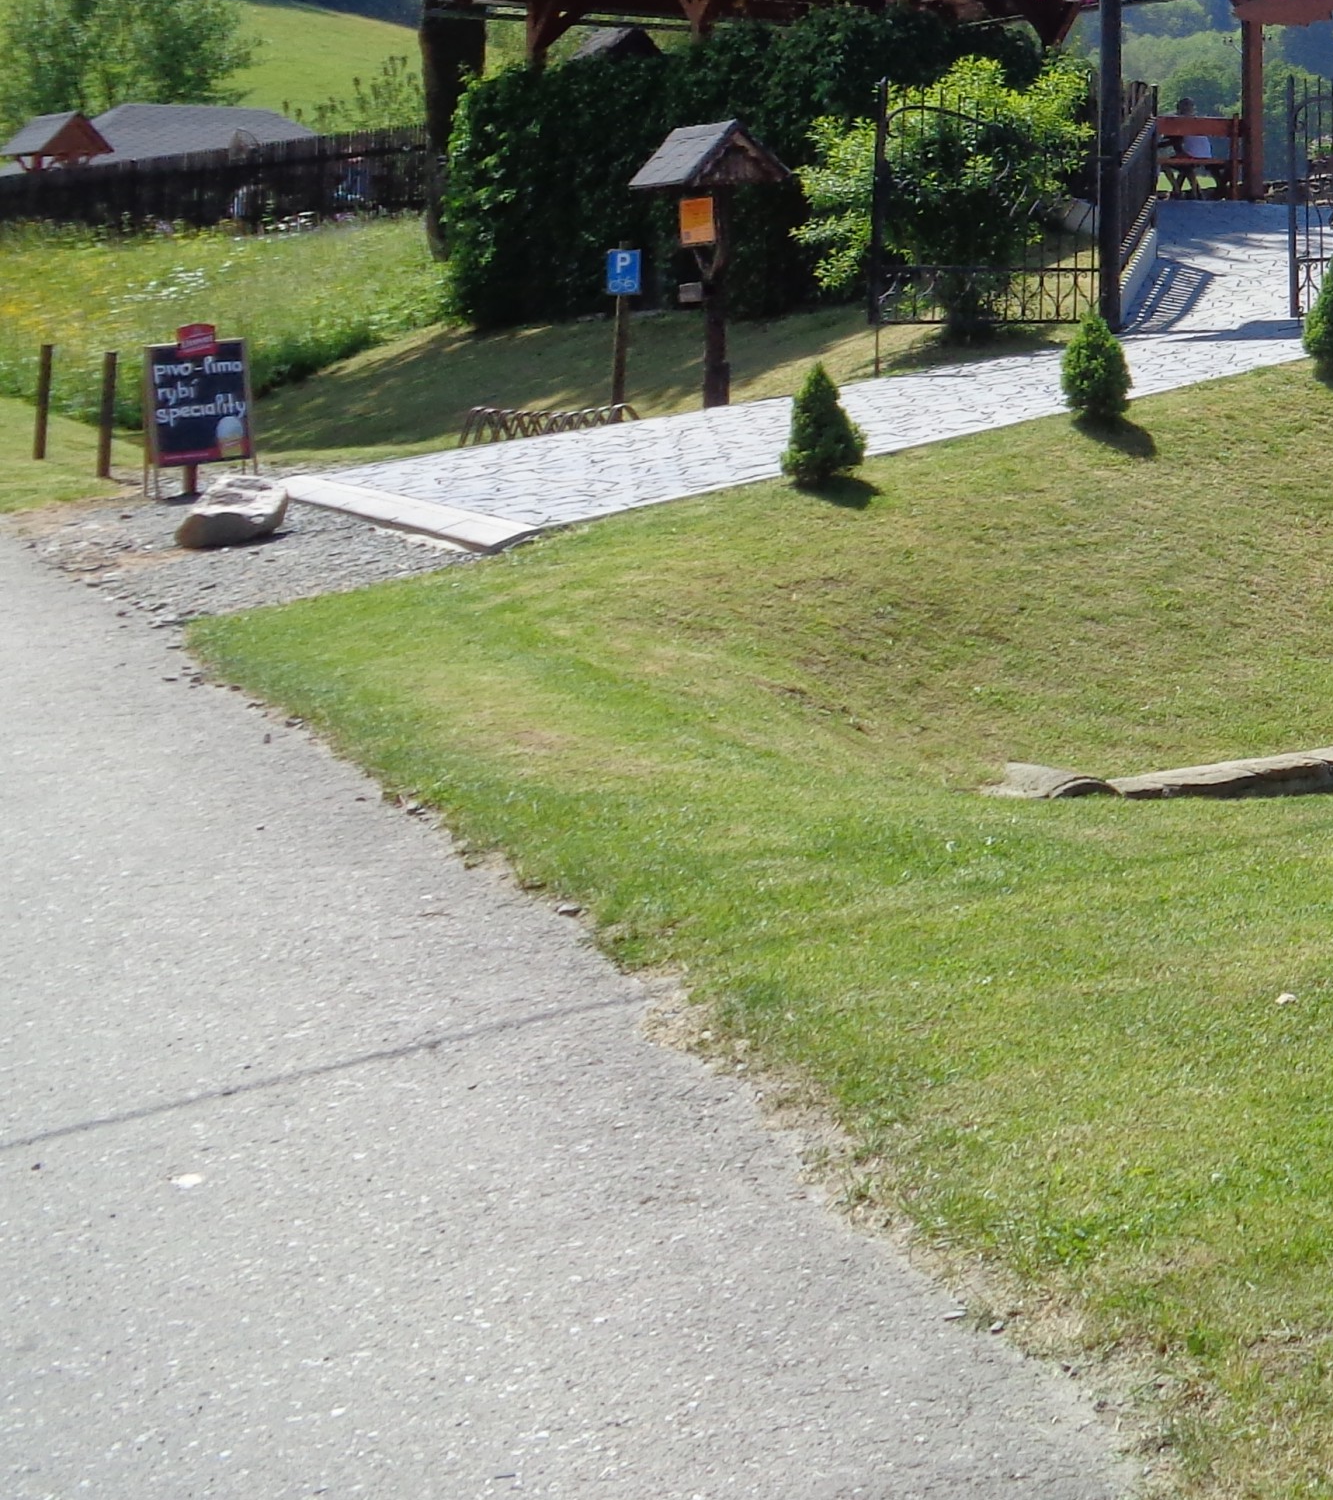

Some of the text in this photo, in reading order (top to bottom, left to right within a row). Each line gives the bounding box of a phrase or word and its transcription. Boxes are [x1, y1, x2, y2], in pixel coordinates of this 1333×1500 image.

[616, 253, 631, 273] P
[157, 378, 199, 406] rybí
[155, 393, 247, 427] speciality
